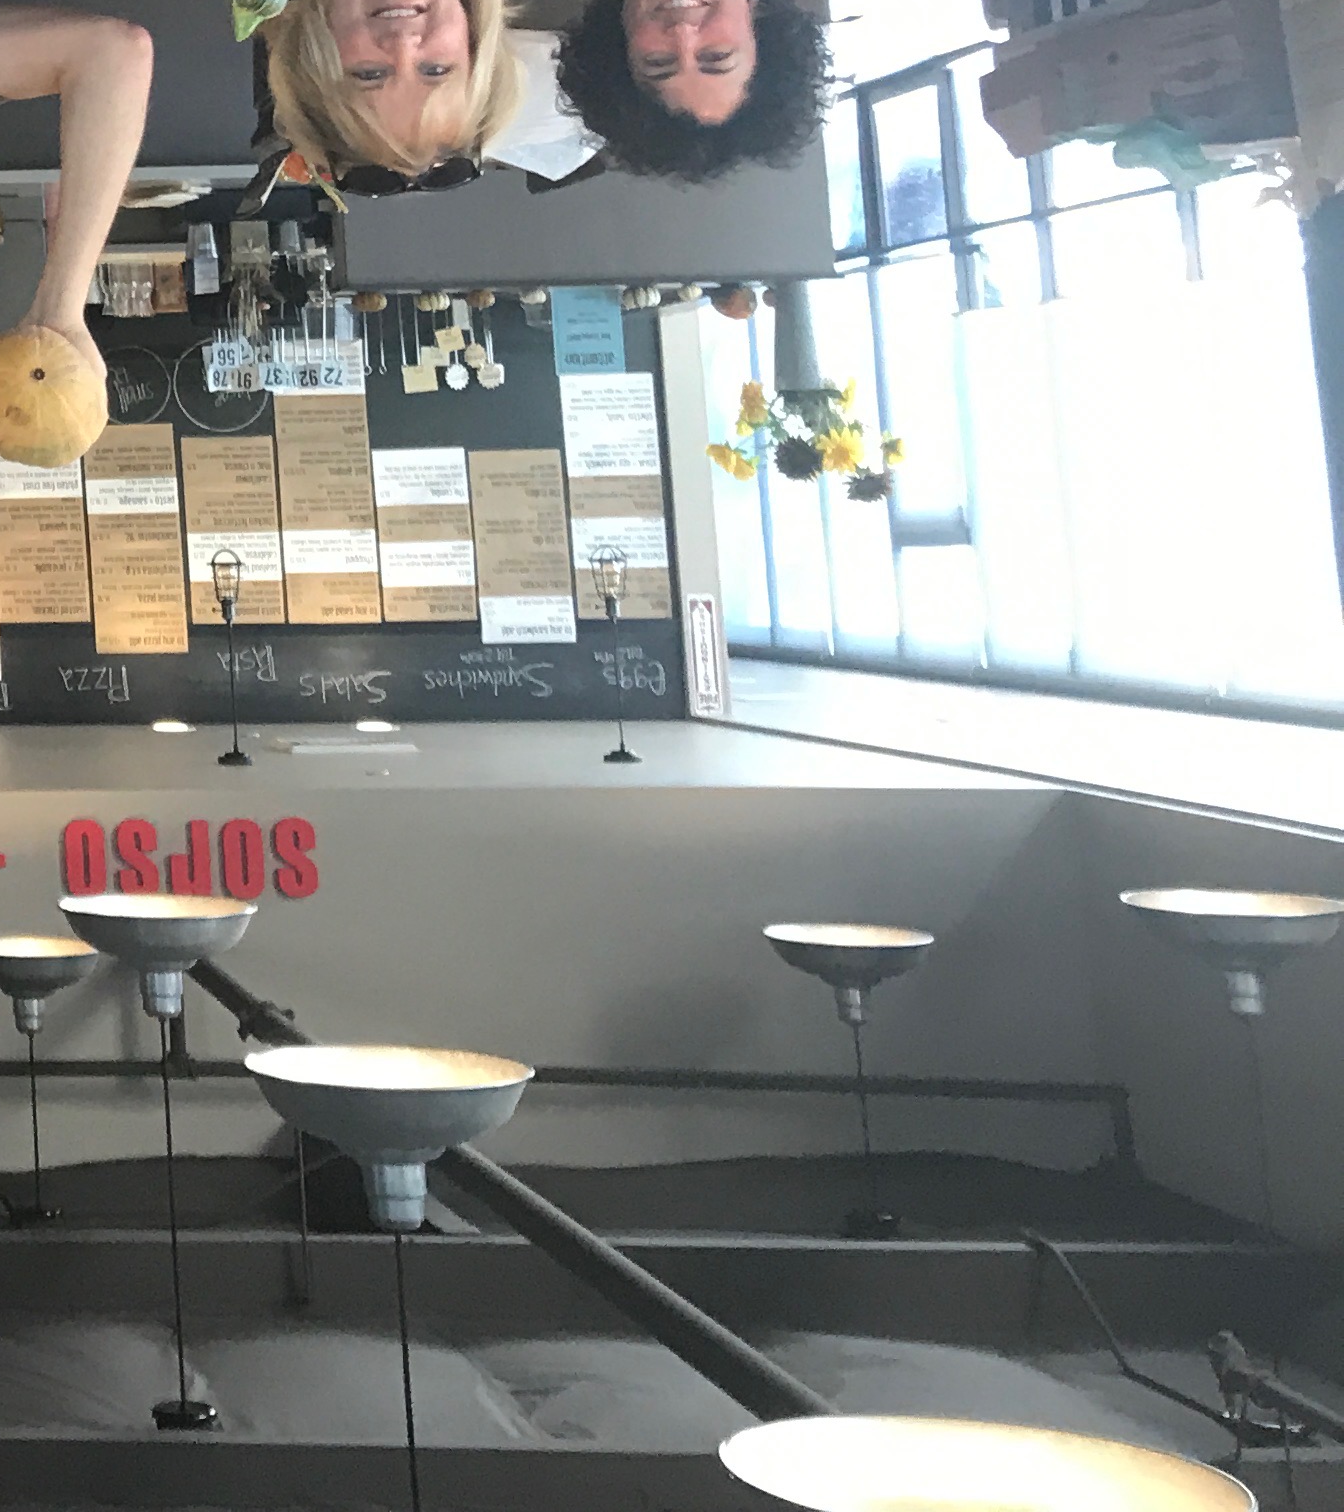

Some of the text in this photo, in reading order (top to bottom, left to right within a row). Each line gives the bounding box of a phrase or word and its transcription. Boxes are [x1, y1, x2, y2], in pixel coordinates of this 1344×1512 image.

[218, 348, 236, 366] 56
[212, 370, 228, 387] 78
[236, 372, 252, 390] 91
[264, 368, 282, 386] 37
[298, 370, 318, 386] 92
[323, 368, 344, 386] 72
[58, 664, 130, 705] Pizza
[299, 670, 392, 704] Salads
[424, 662, 554, 699] Sandwiches
[62, 818, 318, 904] sorso
